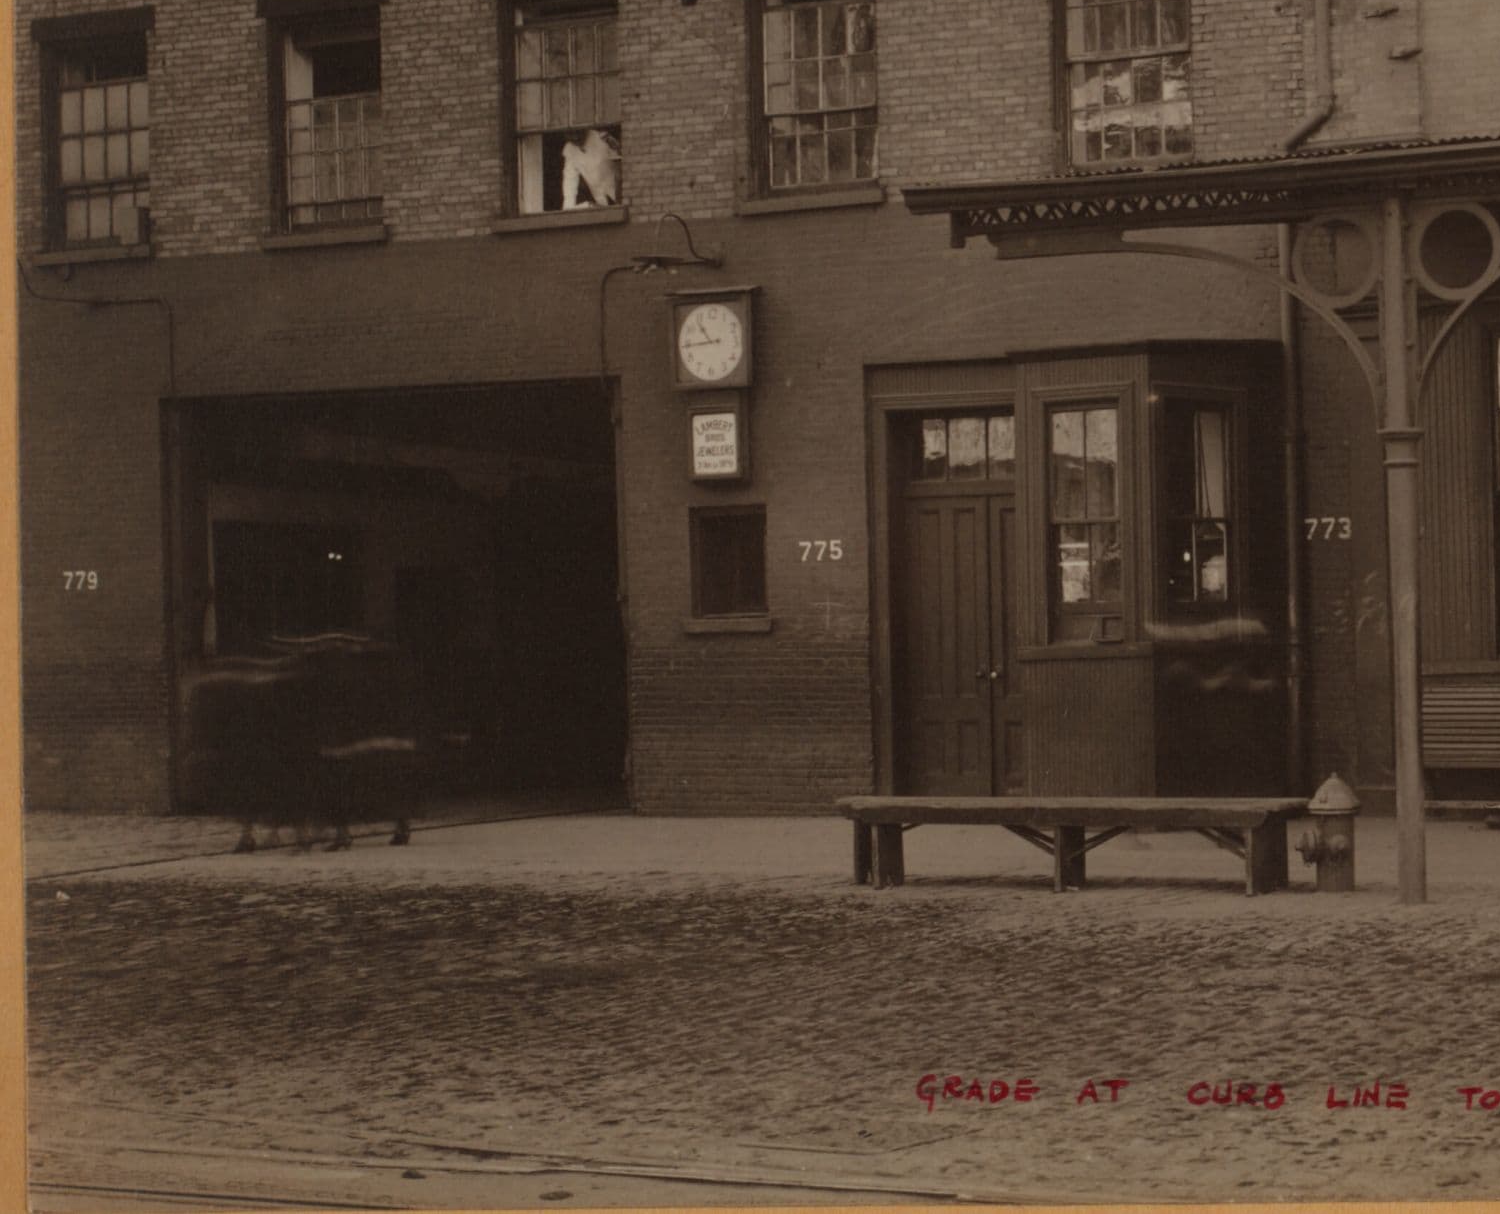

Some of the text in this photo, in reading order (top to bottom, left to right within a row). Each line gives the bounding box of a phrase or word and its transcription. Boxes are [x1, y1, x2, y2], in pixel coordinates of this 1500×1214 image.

[1304, 517, 1352, 540] 773
[799, 539, 843, 562] 775
[63, 570, 98, 591] 779
